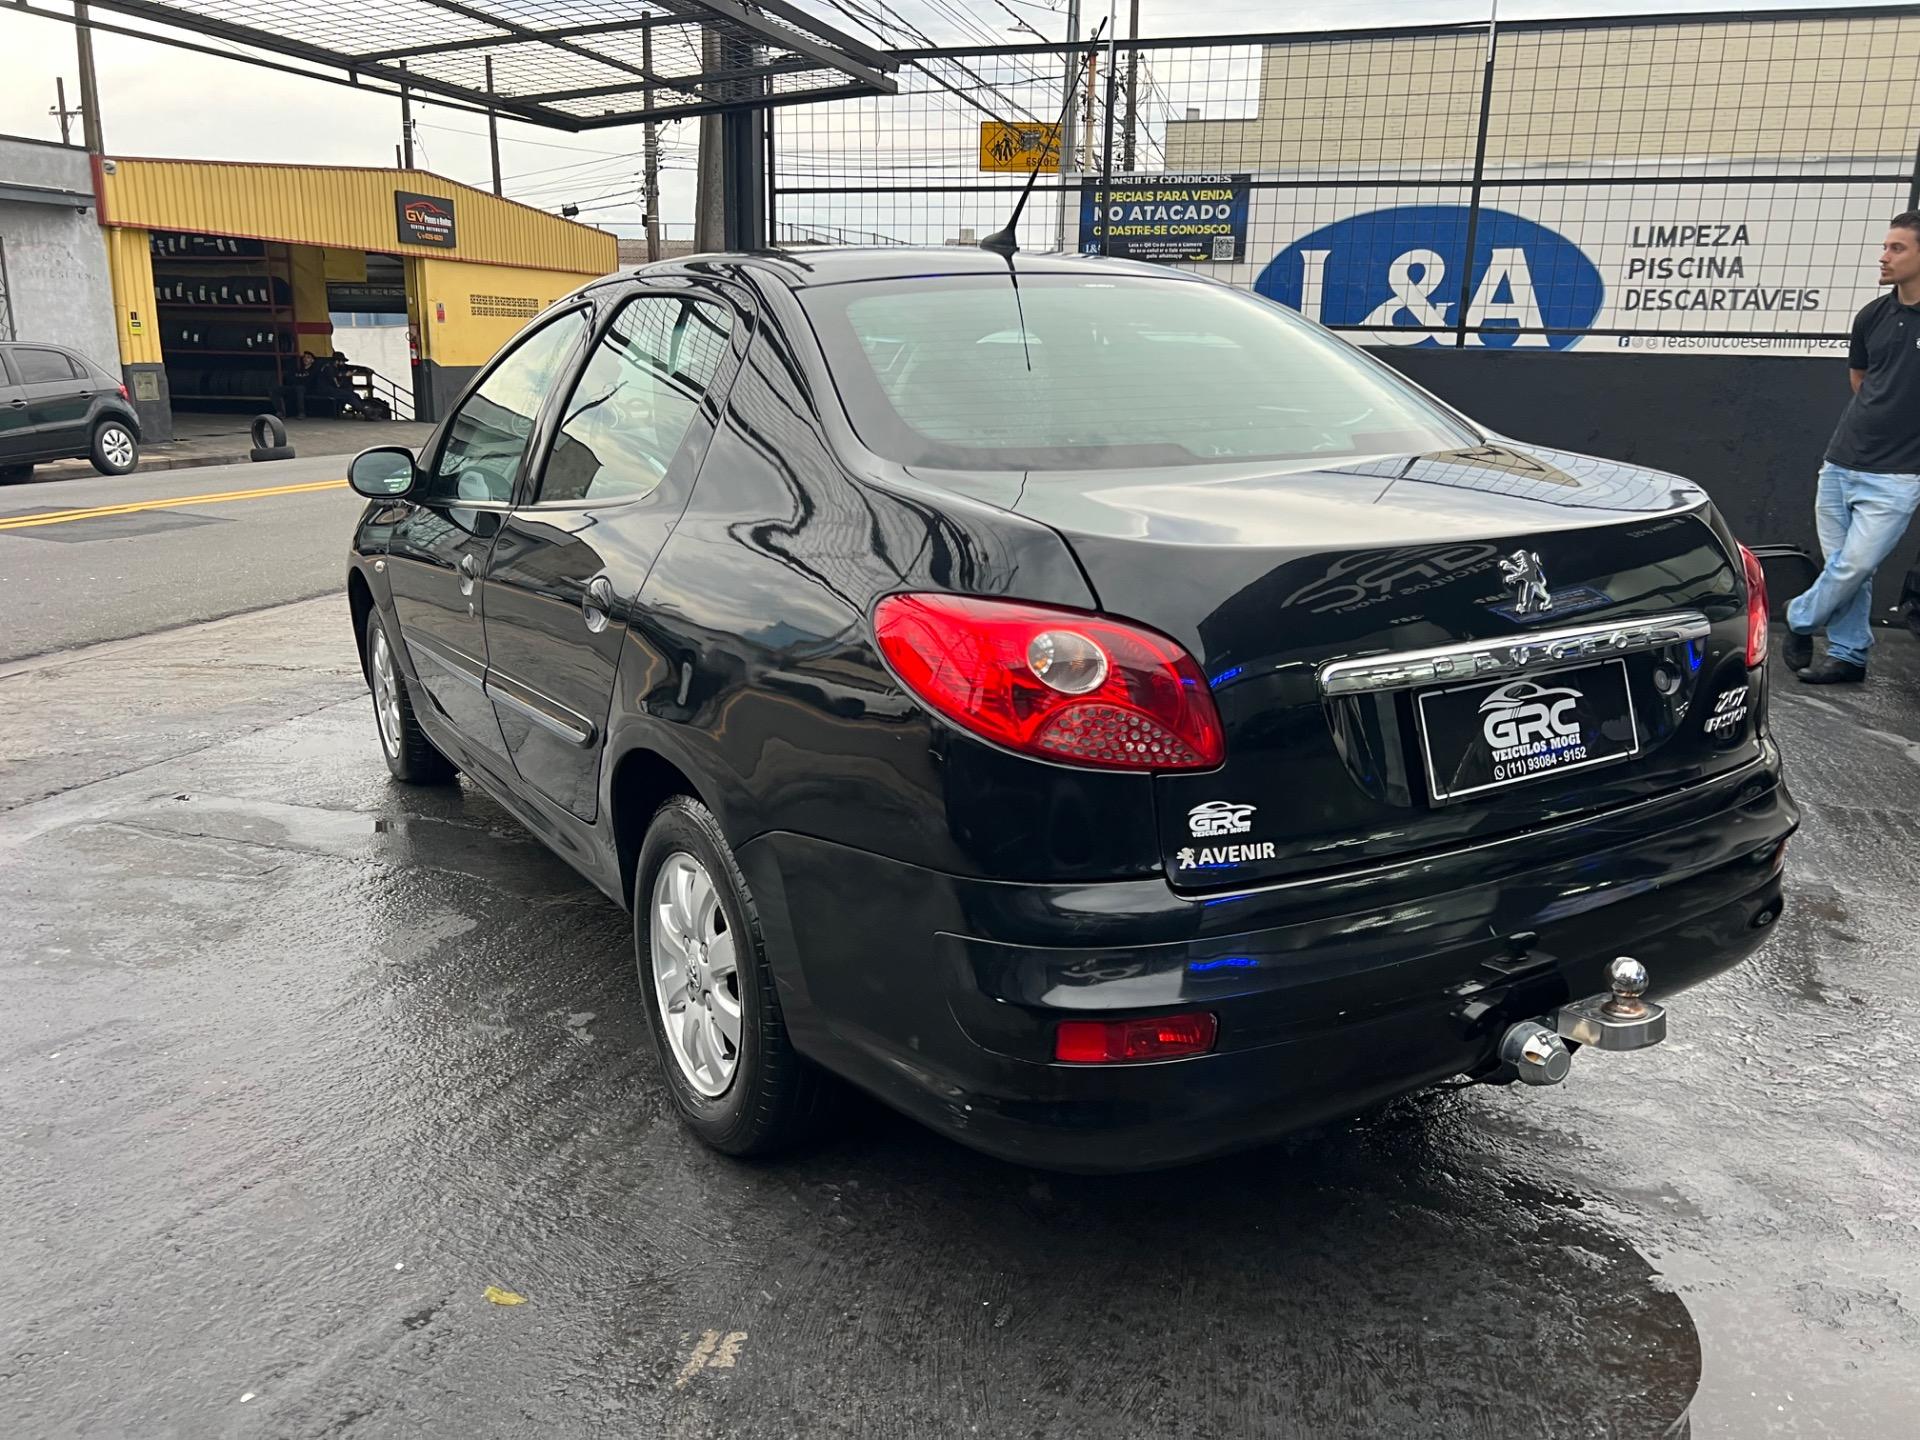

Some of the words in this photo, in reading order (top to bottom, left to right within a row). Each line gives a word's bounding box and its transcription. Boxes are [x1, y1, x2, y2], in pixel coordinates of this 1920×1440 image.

[1094, 190, 1154, 202] EPECIAIS
[1156, 190, 1189, 201] PARA
[1191, 189, 1233, 201] VENDA
[405, 209, 425, 223] GV
[1129, 204, 1231, 221] ATACADO
[1093, 224, 1167, 236] CDASTRE-SE
[1169, 224, 1231, 235] CONOSCO!
[1632, 223, 1750, 249] LIMPEZA
[1627, 255, 1745, 281] PISCINA
[1624, 283, 1821, 312] DESCARTÁVEIS
[1483, 698, 1580, 749] GRC
[1491, 740, 1548, 763] VEICULOS
[1549, 733, 1582, 751] MOGI
[1506, 760, 1527, 778] (11)
[1527, 754, 1557, 771] 93084
[1563, 746, 1587, 765] 9152
[1189, 809, 1252, 832] GRC
[1198, 842, 1276, 865] AVENIR
